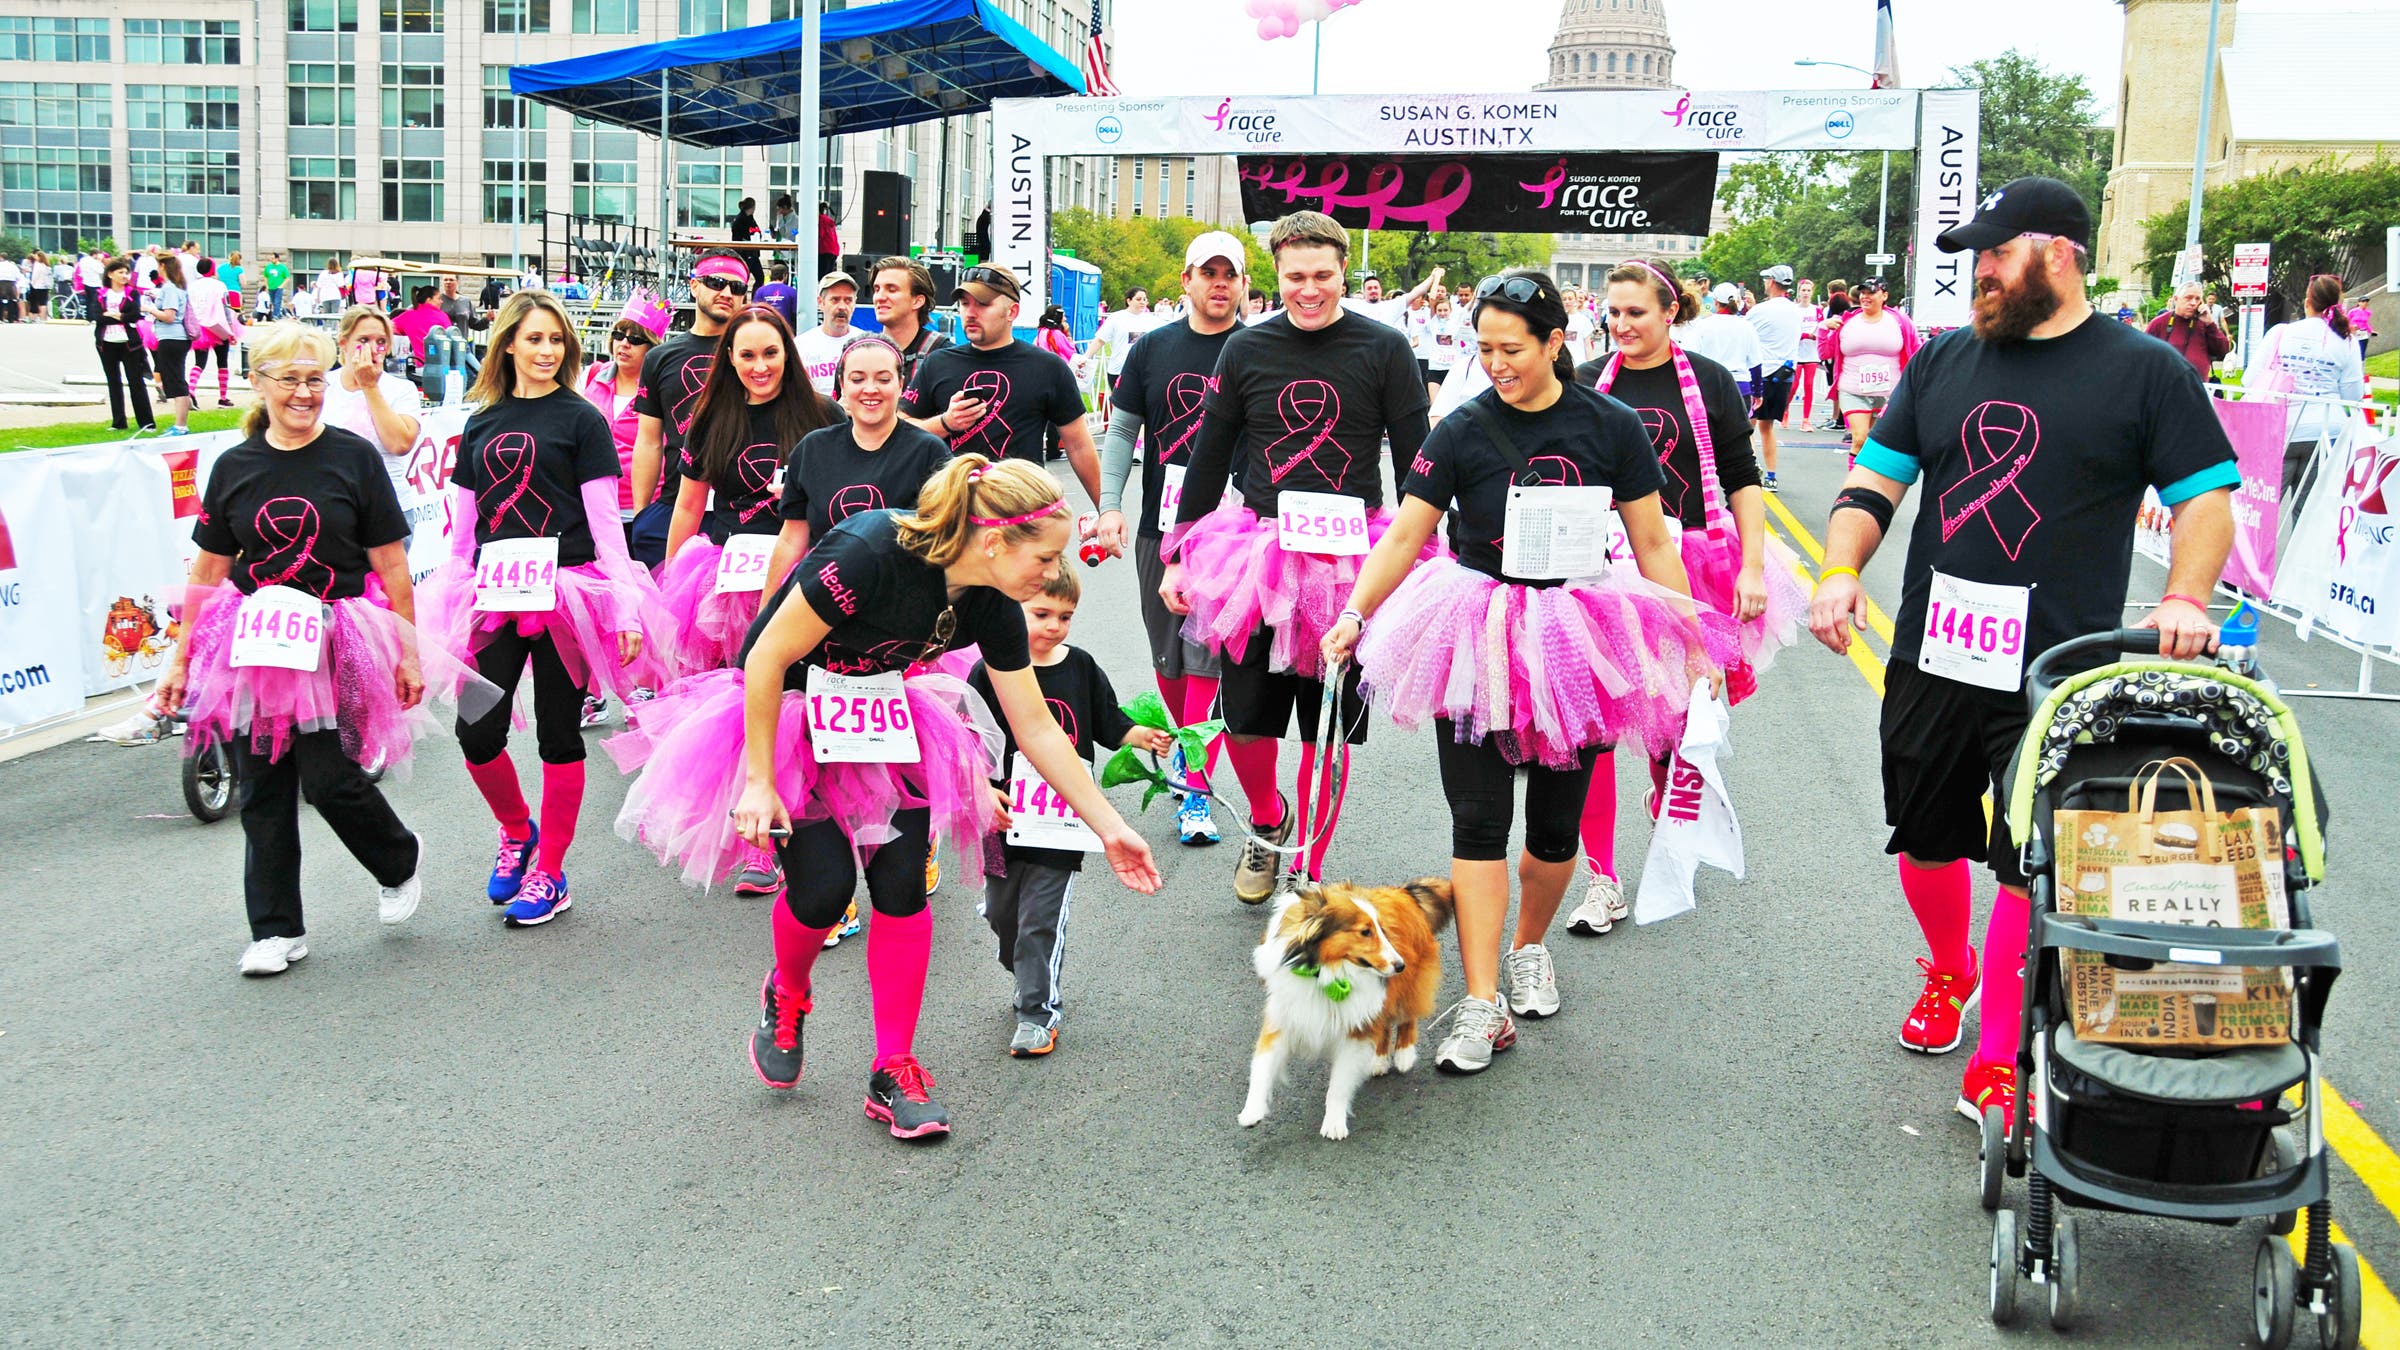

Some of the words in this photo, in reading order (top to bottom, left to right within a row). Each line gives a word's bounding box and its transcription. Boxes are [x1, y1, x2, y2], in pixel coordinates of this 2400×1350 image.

[1056, 102, 1114, 113] Presenting
[1118, 102, 1165, 112] Sponsor
[1783, 96, 1847, 106] Presenting
[1851, 95, 1902, 106] Sponsor
[1380, 105, 1449, 120] SUSAN
[1456, 105, 1475, 120] G.
[1483, 104, 1557, 120] KOMEN
[1688, 111, 1737, 126] race
[1099, 126, 1119, 134] DELL
[1228, 115, 1275, 130] race
[1828, 120, 1851, 128] DELL
[1008, 133, 1032, 249] AUSTIN,
[1561, 185, 1639, 208] race
[1934, 259, 1958, 297] TX
[1861, 371, 1889, 383] 10592
[1282, 511, 1364, 537] 12598
[720, 551, 766, 575] 125
[477, 560, 554, 588] 14464
[238, 609, 319, 643] 14466
[1928, 601, 2022, 655] 14469
[811, 694, 910, 734] 12596
[1012, 778, 1081, 818] 144
[2077, 895, 2108, 903] BLACK
[2128, 897, 2221, 912] REALLY
[2077, 904, 2109, 913] LIMA
[2088, 965, 2099, 1008] MAINE
[2100, 965, 2112, 996] LIVE
[2076, 965, 2087, 1021] LOBSTER
[2119, 1001, 2159, 1010] MADE
[2219, 1001, 2285, 1014] TRUFFLE
[2163, 995, 2176, 1039] INDIA
[2219, 1014, 2287, 1026] TREMOR
[2120, 1028, 2144, 1037] INK
[2220, 1026, 2288, 1039] QUES
